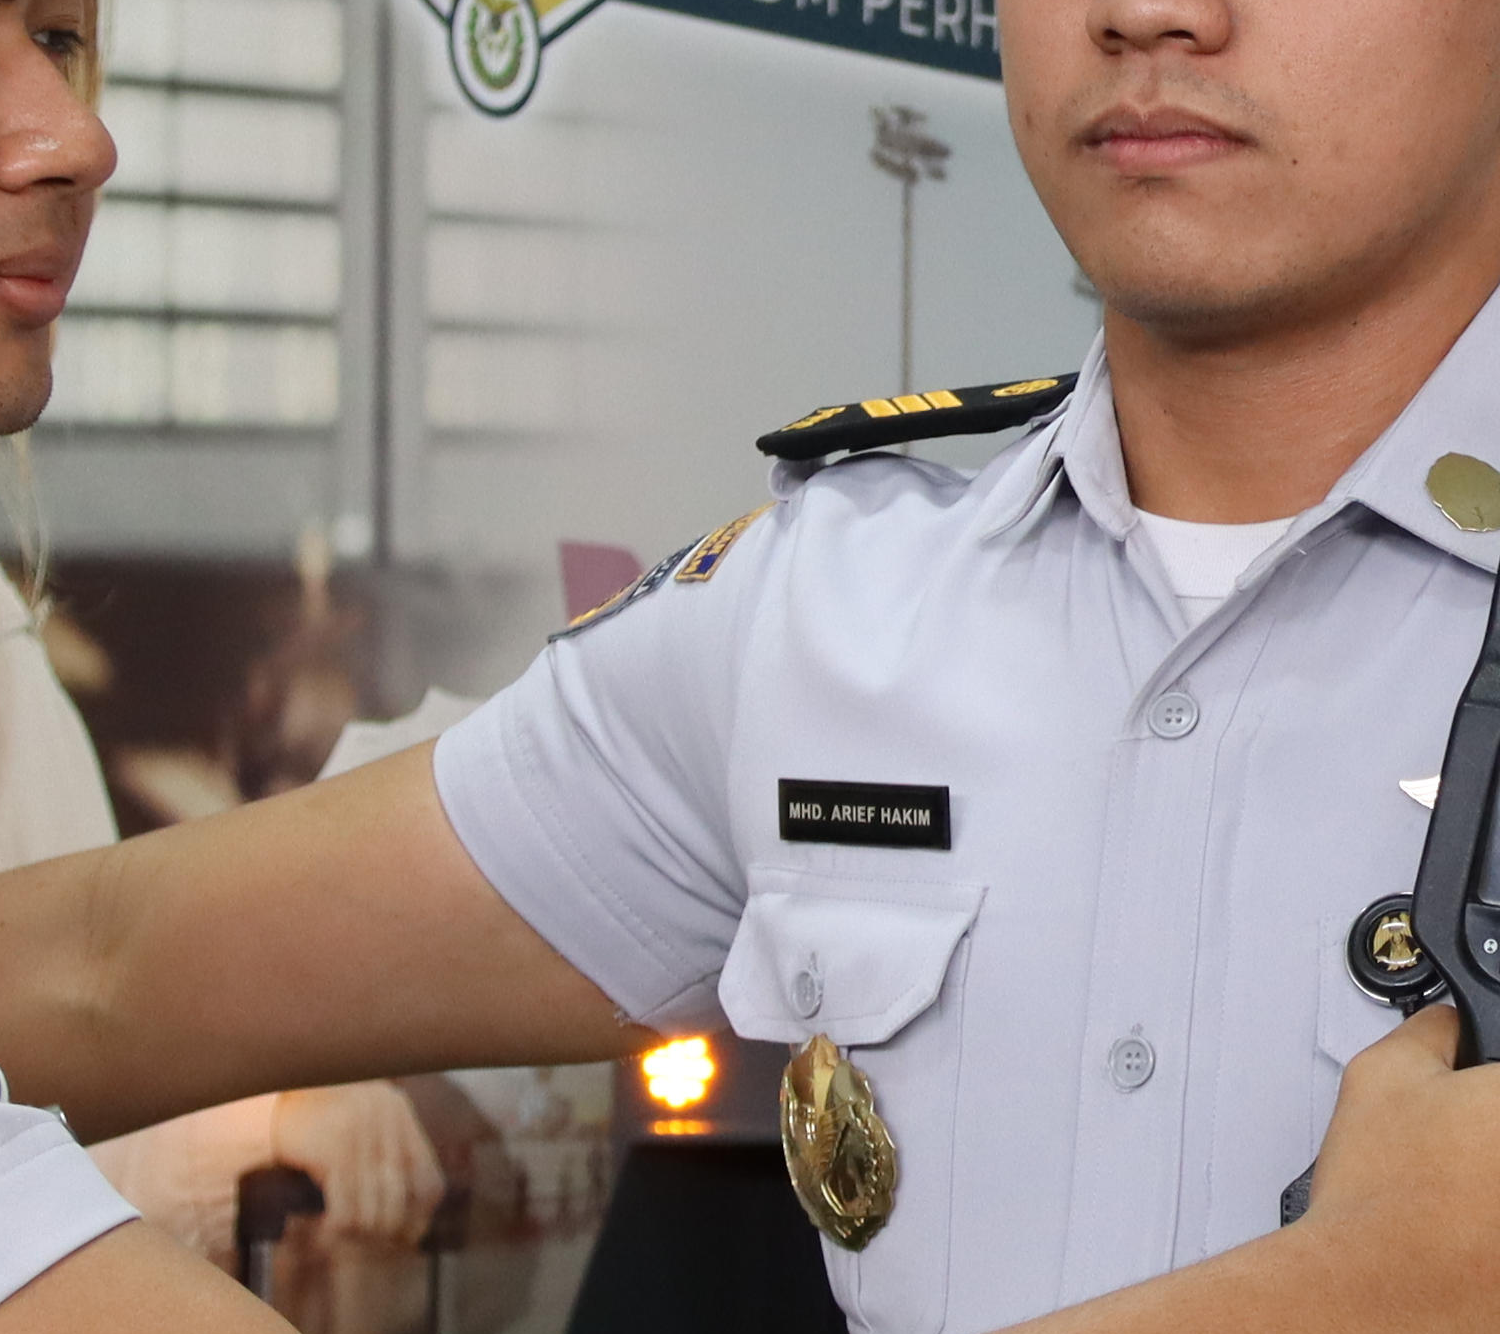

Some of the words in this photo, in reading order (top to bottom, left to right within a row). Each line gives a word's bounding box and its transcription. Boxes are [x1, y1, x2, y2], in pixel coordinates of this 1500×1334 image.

[789, 802, 826, 820] MHD.
[831, 805, 876, 823] ARIEF
[880, 807, 931, 826] HAKIM
